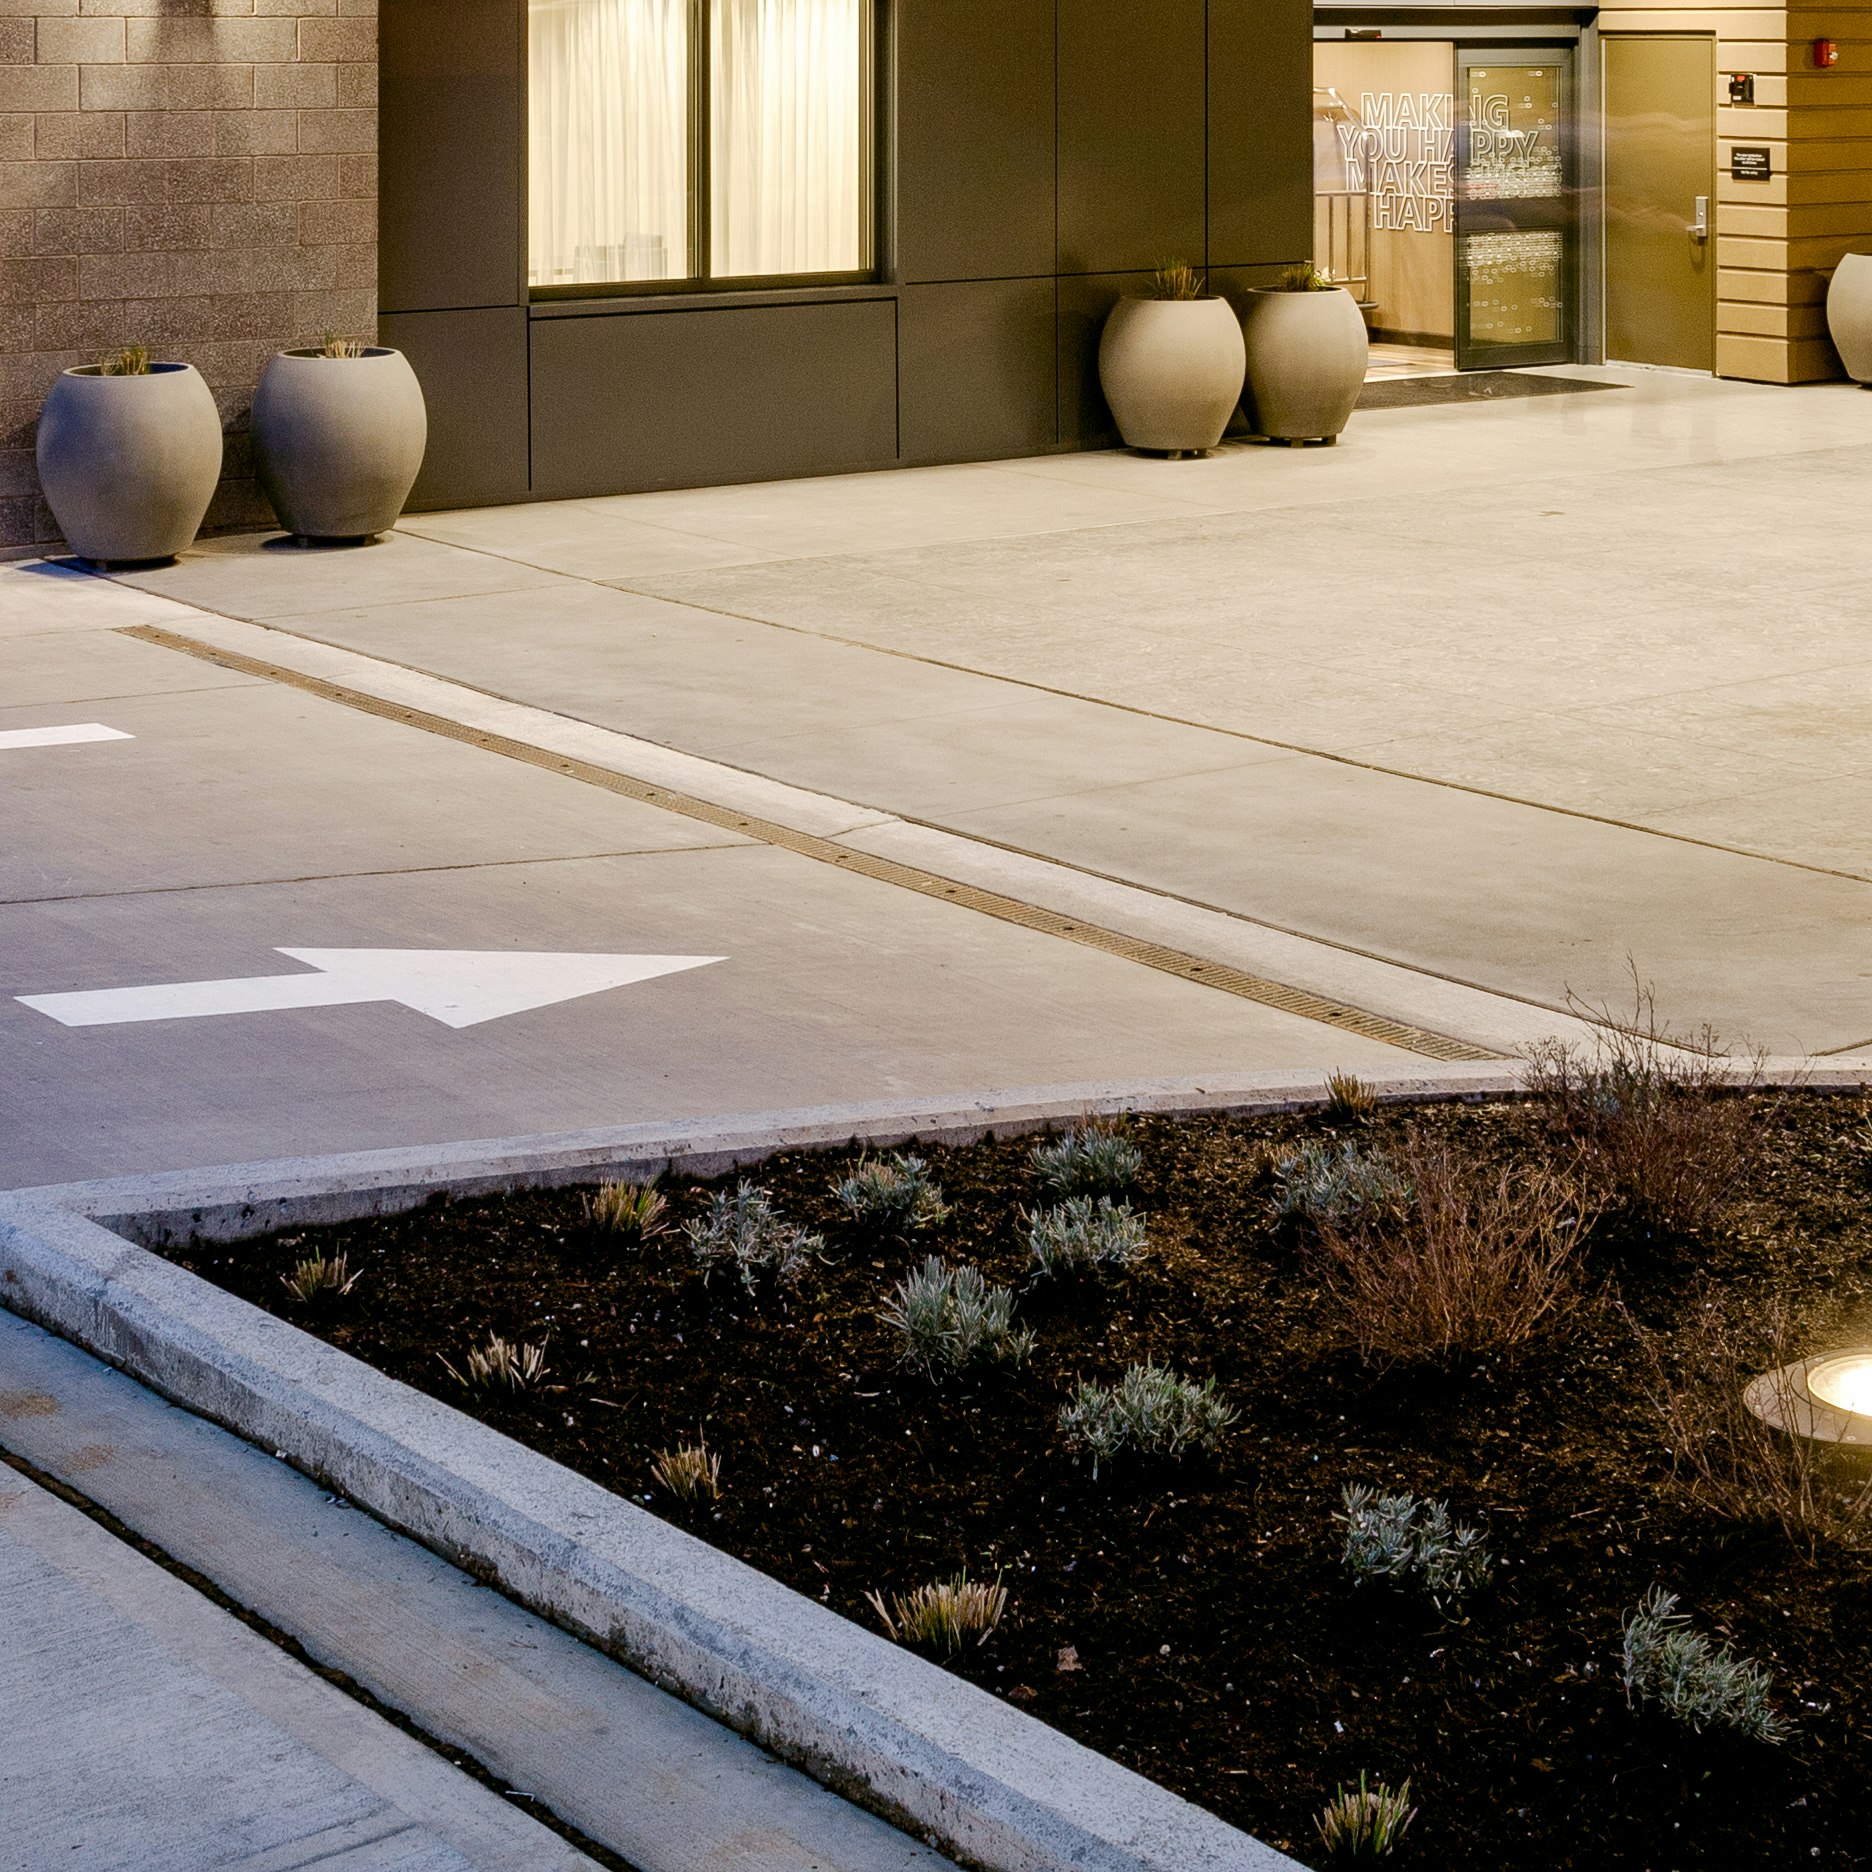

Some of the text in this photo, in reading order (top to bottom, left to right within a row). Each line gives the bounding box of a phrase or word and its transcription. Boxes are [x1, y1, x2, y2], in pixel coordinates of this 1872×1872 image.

[1337, 125, 1407, 162] YOU
[1346, 159, 1454, 199] MAKE
[1374, 193, 1454, 234] HAPP
